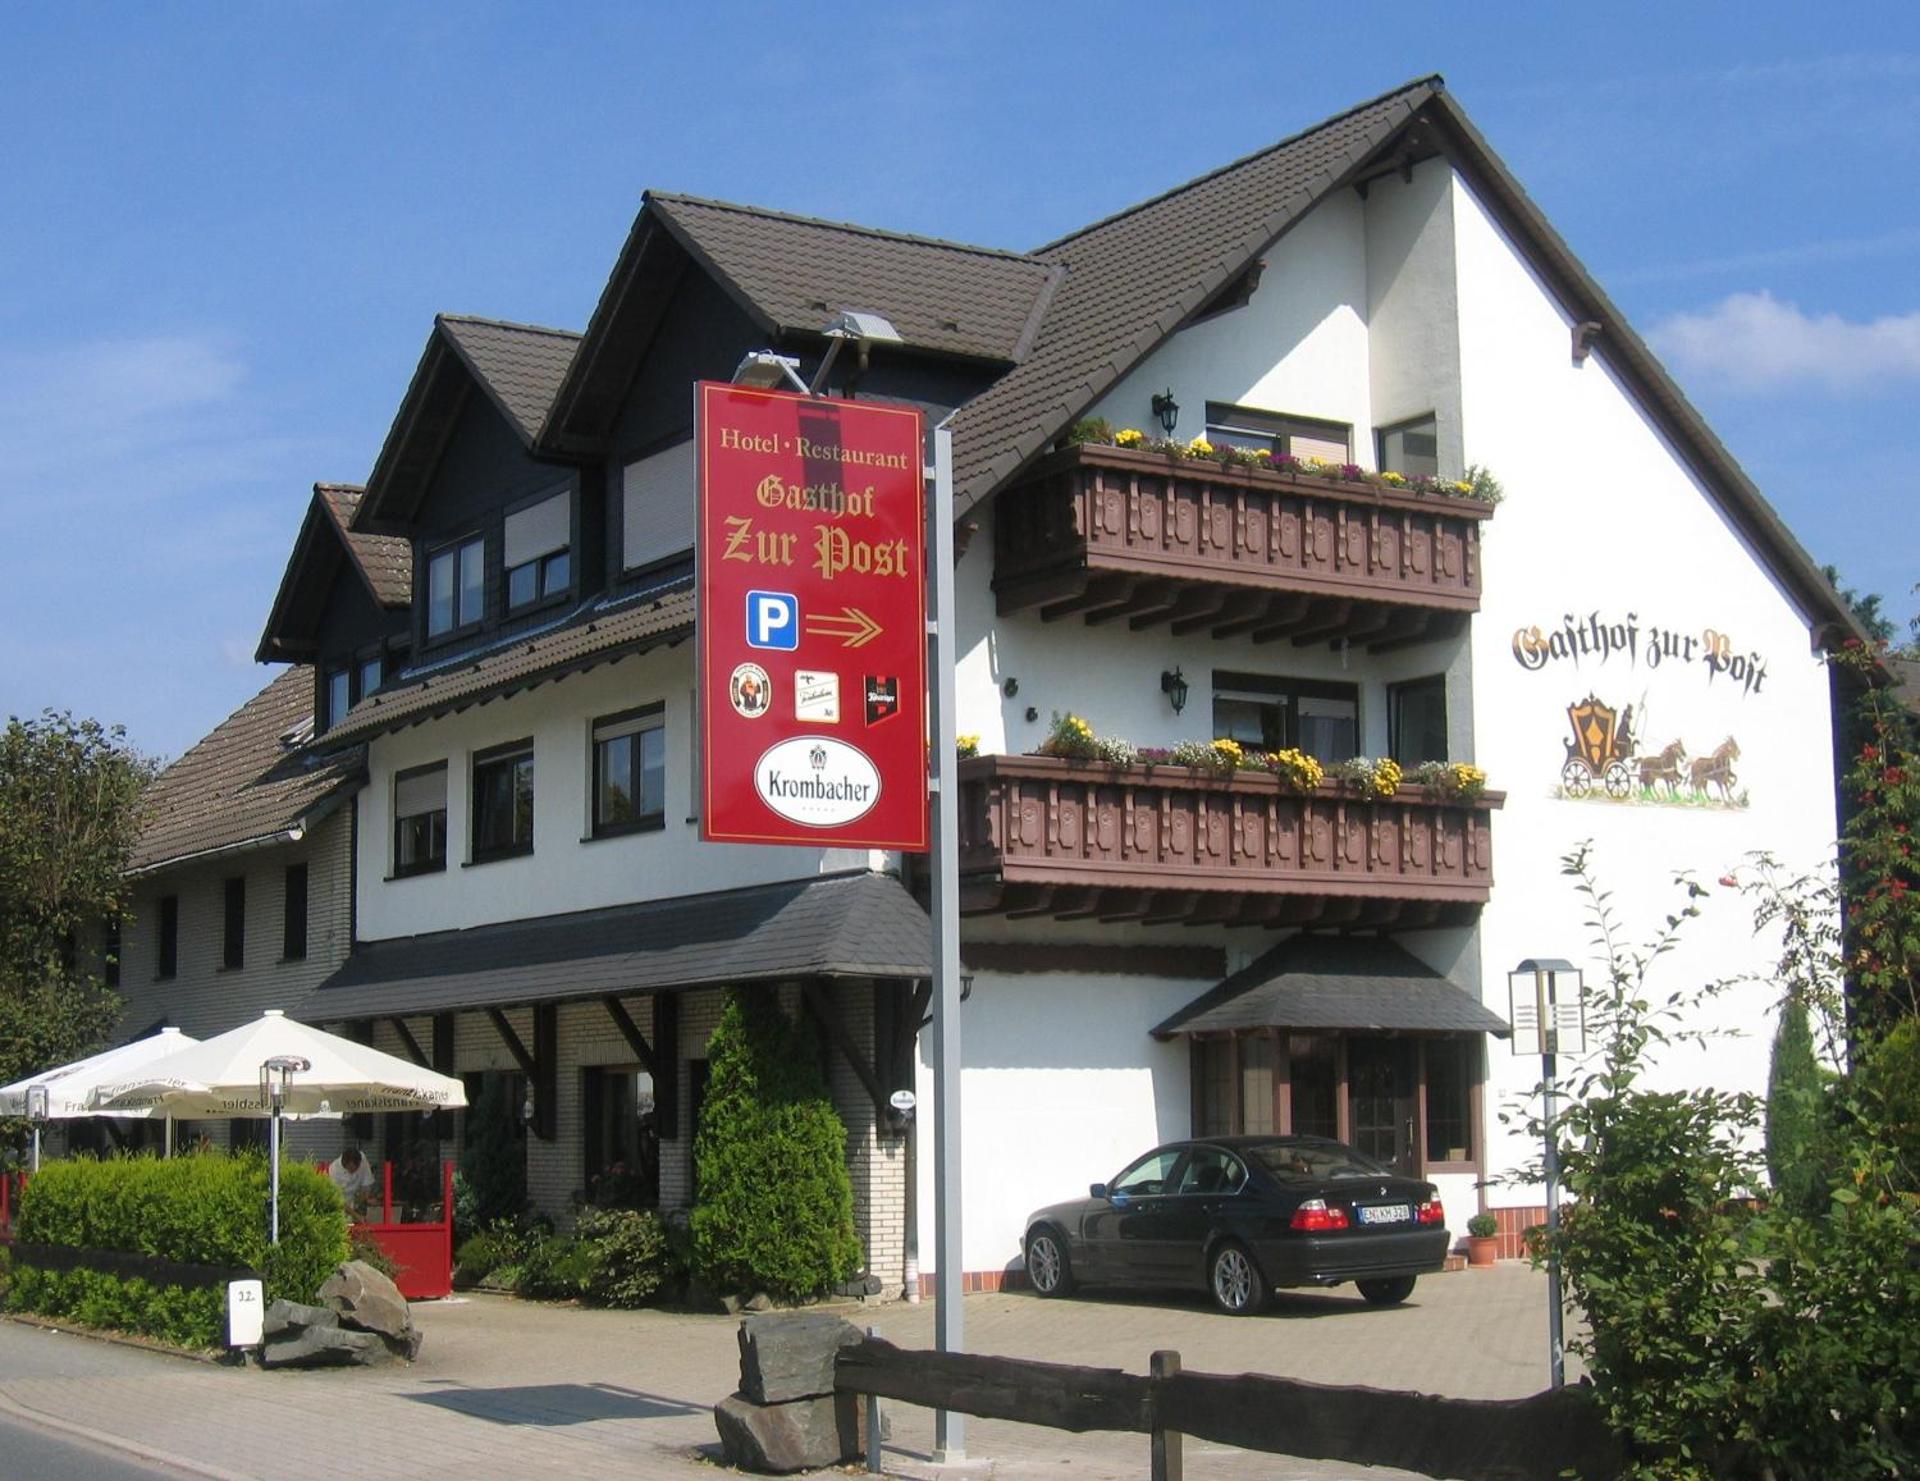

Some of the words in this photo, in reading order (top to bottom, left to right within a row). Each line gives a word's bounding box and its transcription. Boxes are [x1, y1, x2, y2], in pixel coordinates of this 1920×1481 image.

[720, 428, 779, 454] Hotel
[795, 437, 908, 470] Restaurant
[756, 474, 875, 519] Gasthof
[721, 516, 798, 567] Zur
[812, 524, 909, 580] Post
[758, 597, 790, 642] P
[1646, 625, 1699, 670] zur
[769, 769, 871, 802] Krombacher
